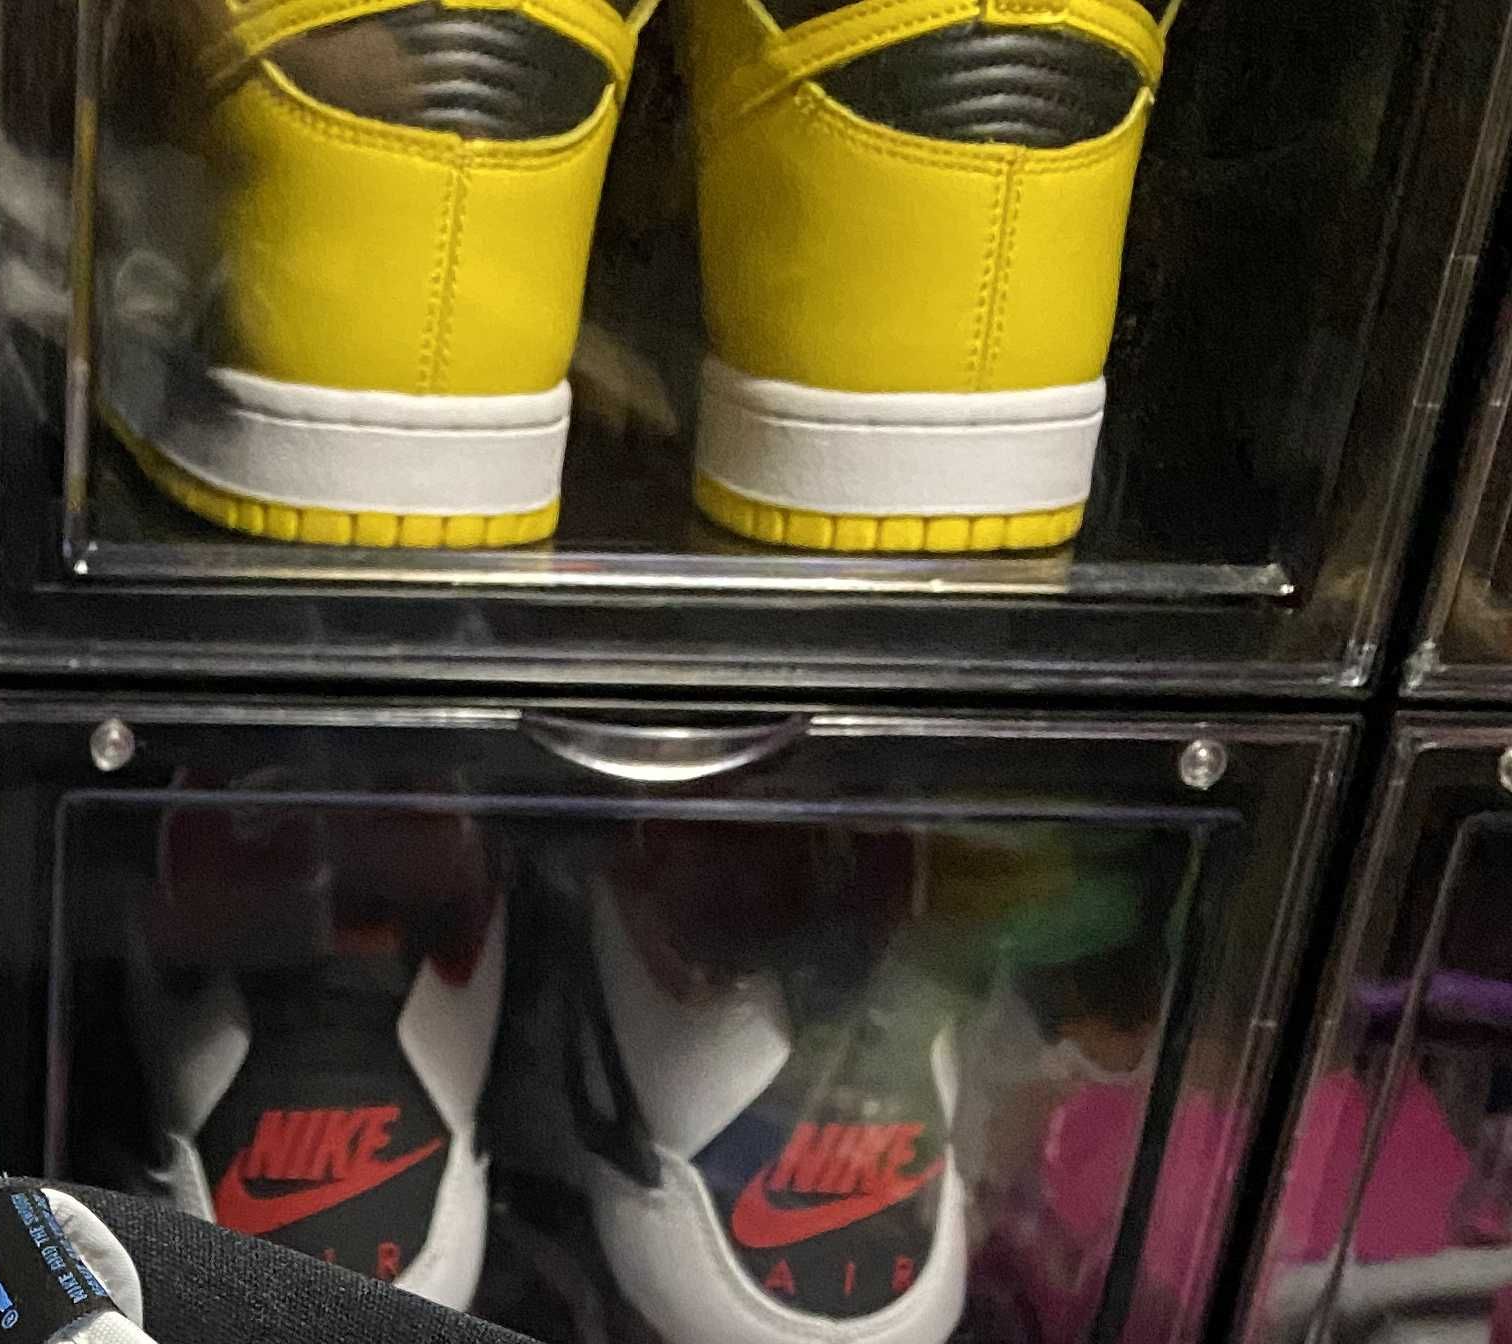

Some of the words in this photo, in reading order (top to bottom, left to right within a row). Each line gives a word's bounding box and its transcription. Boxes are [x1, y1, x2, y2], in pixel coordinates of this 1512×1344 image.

[247, 1105, 401, 1180] NIKE
[765, 1121, 928, 1193] NIKE
[763, 1257, 915, 1297] AIR
